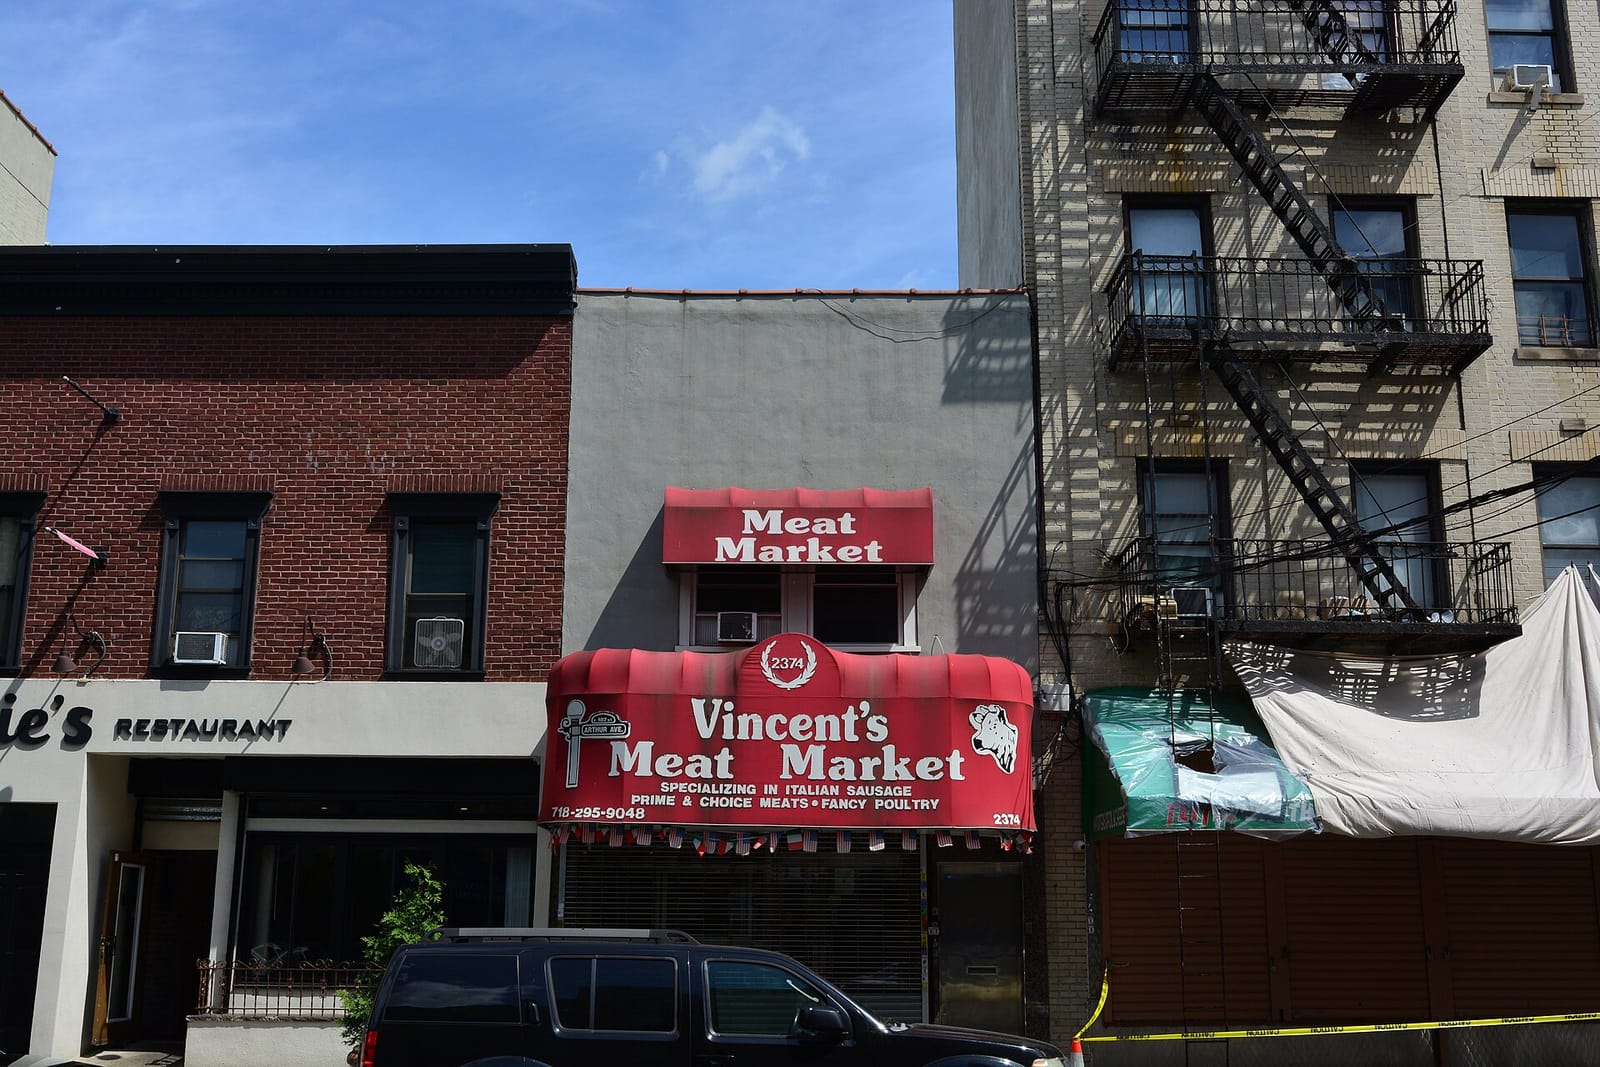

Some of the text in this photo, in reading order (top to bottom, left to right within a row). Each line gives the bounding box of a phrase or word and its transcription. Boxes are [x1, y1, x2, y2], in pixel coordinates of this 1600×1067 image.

[742, 509, 857, 535] Meat
[714, 537, 884, 563] Market
[771, 656, 805, 672] 2374
[690, 697, 889, 743] Vincent's
[115, 718, 292, 740] RESTAURANT
[583, 725, 608, 734] ARTHUR
[607, 740, 966, 782] Meat Market
[660, 782, 912, 797] SPECIALIZING IN ITALIAN SAUSAGE
[631, 794, 940, 811] PRIME & CHOICE MEATS FANCY POULTRY
[551, 806, 645, 820] 718-295-9048
[992, 813, 1021, 826] 2374
